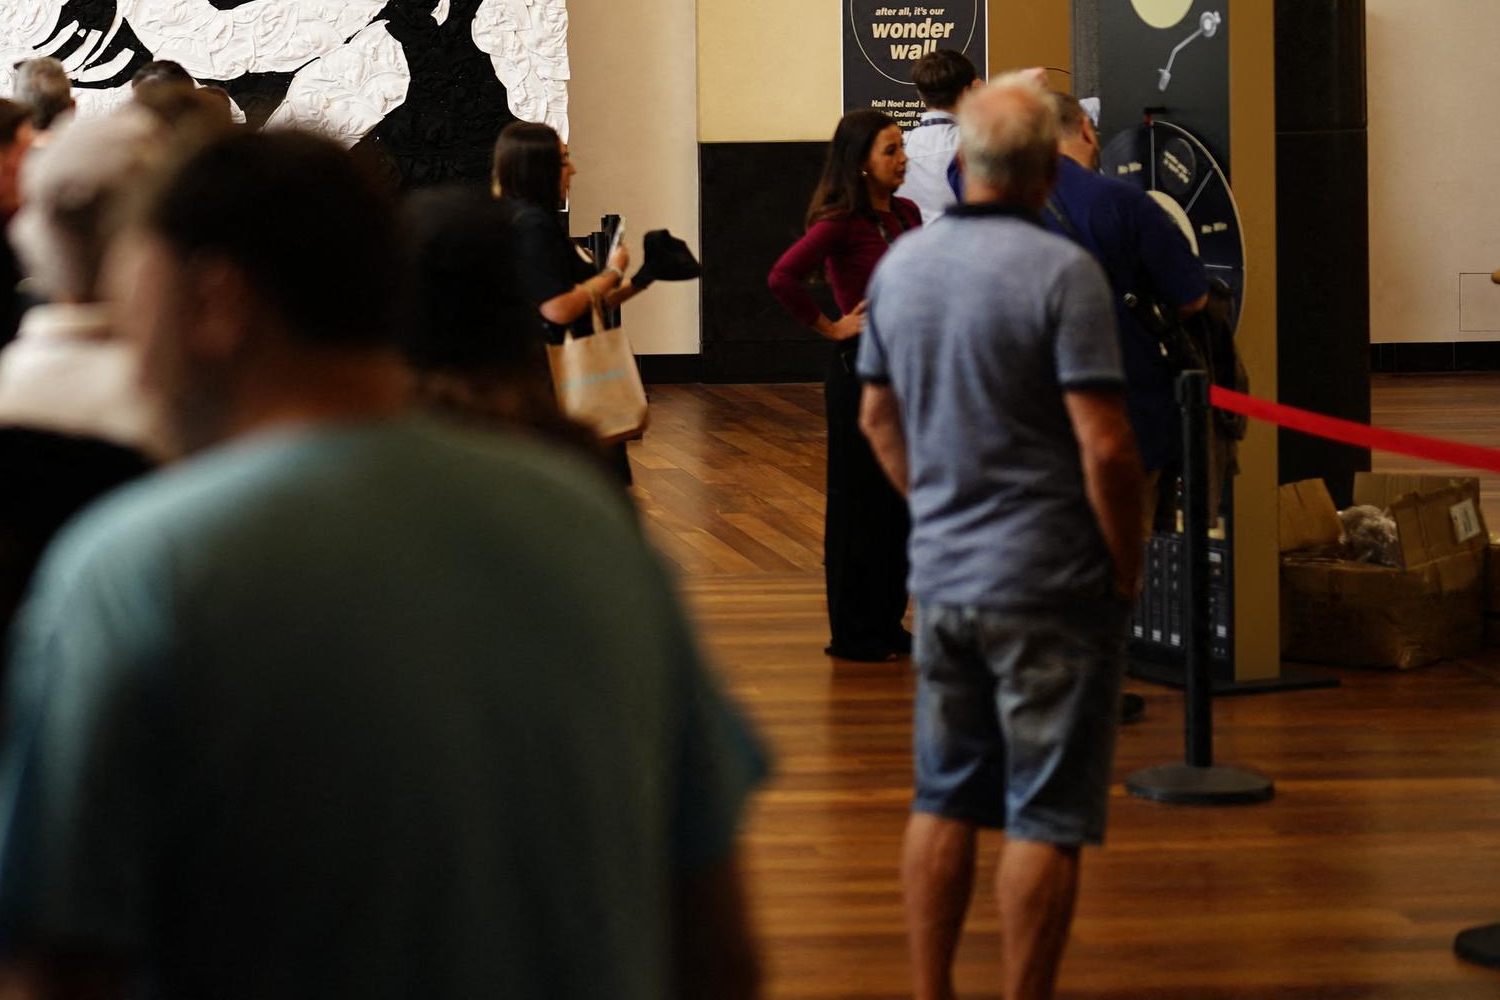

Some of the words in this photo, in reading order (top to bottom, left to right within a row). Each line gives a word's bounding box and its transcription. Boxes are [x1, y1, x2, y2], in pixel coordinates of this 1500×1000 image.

[876, 7, 897, 16] after
[898, 7, 911, 17] all,
[914, 7, 927, 16] it's
[872, 18, 954, 38] wonder
